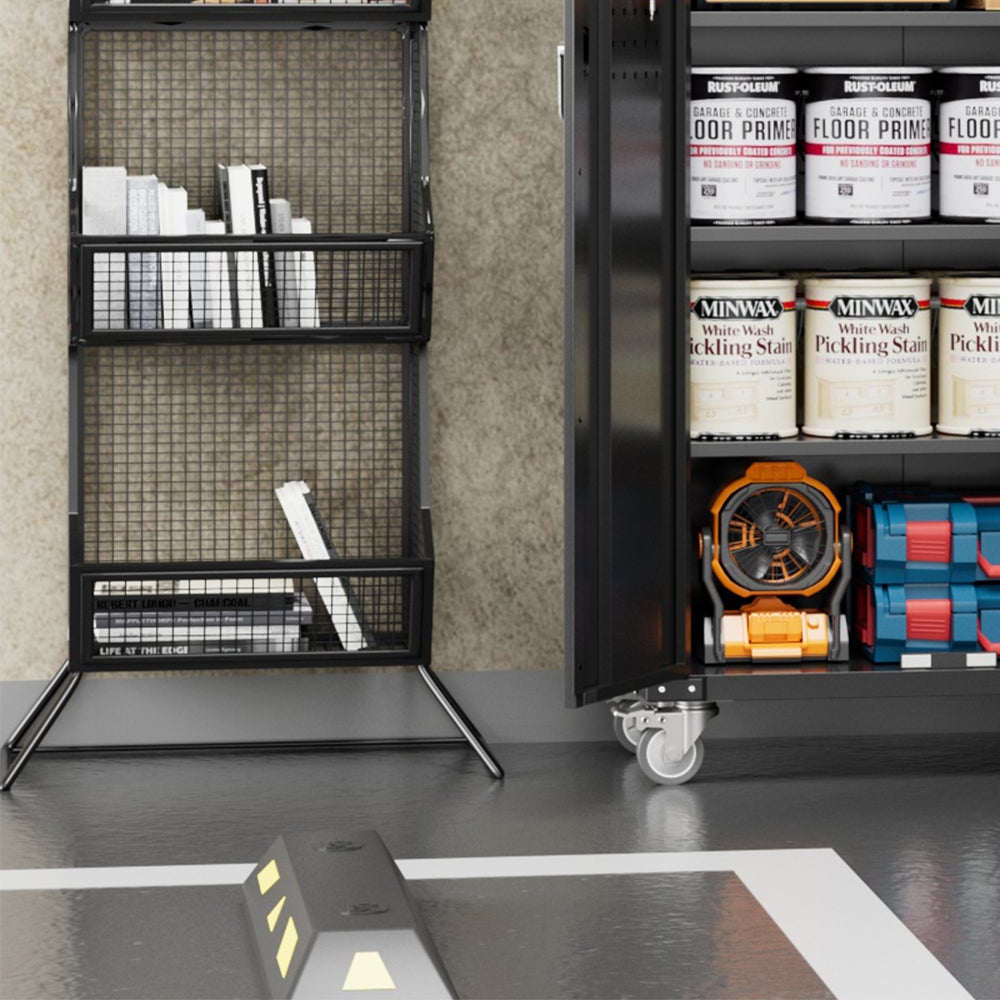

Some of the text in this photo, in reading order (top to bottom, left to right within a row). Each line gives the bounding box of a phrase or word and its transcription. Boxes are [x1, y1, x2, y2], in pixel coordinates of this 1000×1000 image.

[707, 81, 779, 93] RUST-OLEUM
[844, 81, 914, 93] RUST-OLEUM
[693, 106, 787, 118] GARAGE & CONCRETE
[830, 106, 923, 117] GARAGE & CONCRETE
[691, 120, 732, 140] OOR
[814, 118, 869, 139] FLOOR
[701, 300, 777, 317] MINWAX
[837, 299, 913, 316] MINWAX
[702, 324, 774, 336] White Wash
[838, 323, 909, 334] White Wash
[690, 337, 792, 359] ickling Stain
[815, 335, 927, 357] Pickling Stain
[99, 647, 121, 655] LIFE
[125, 647, 137, 655] AT
